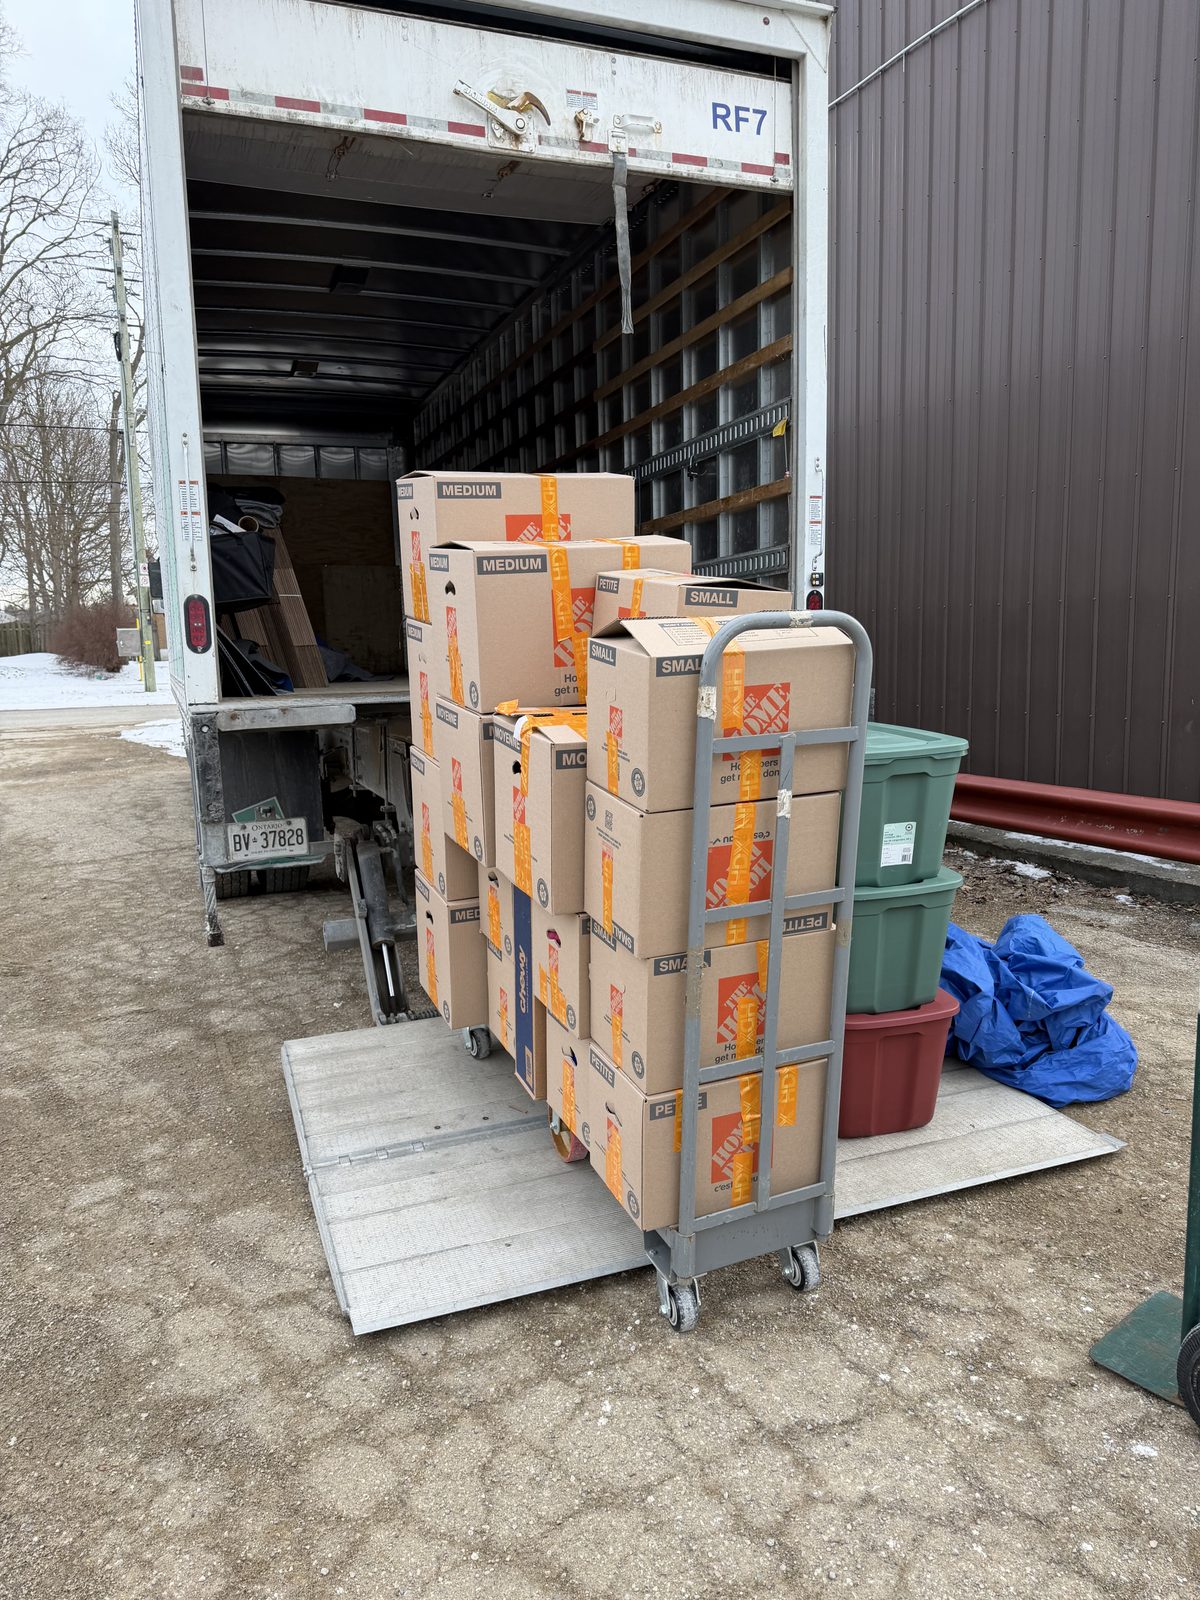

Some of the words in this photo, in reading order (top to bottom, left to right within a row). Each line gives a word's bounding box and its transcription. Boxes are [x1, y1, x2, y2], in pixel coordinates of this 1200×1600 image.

[711, 101, 768, 136] RF7
[442, 484, 497, 496] MEDIUM
[430, 556, 448, 569] MEDIUM
[483, 558, 542, 571] MEDIUM
[600, 579, 618, 591] PETITE
[690, 591, 733, 605] SMALL
[592, 644, 614, 662] SMALL
[662, 659, 702, 674] SMAL
[564, 674, 578, 683] Ho
[554, 682, 571, 696] get
[720, 773, 735, 785] get
[233, 833, 250, 852] BV
[260, 828, 304, 848] 37828
[783, 915, 823, 932] PETIT
[659, 957, 688, 972] SMA
[724, 1043, 737, 1052] Ho
[714, 1052, 728, 1064] get
[590, 1053, 613, 1085] PETITE
